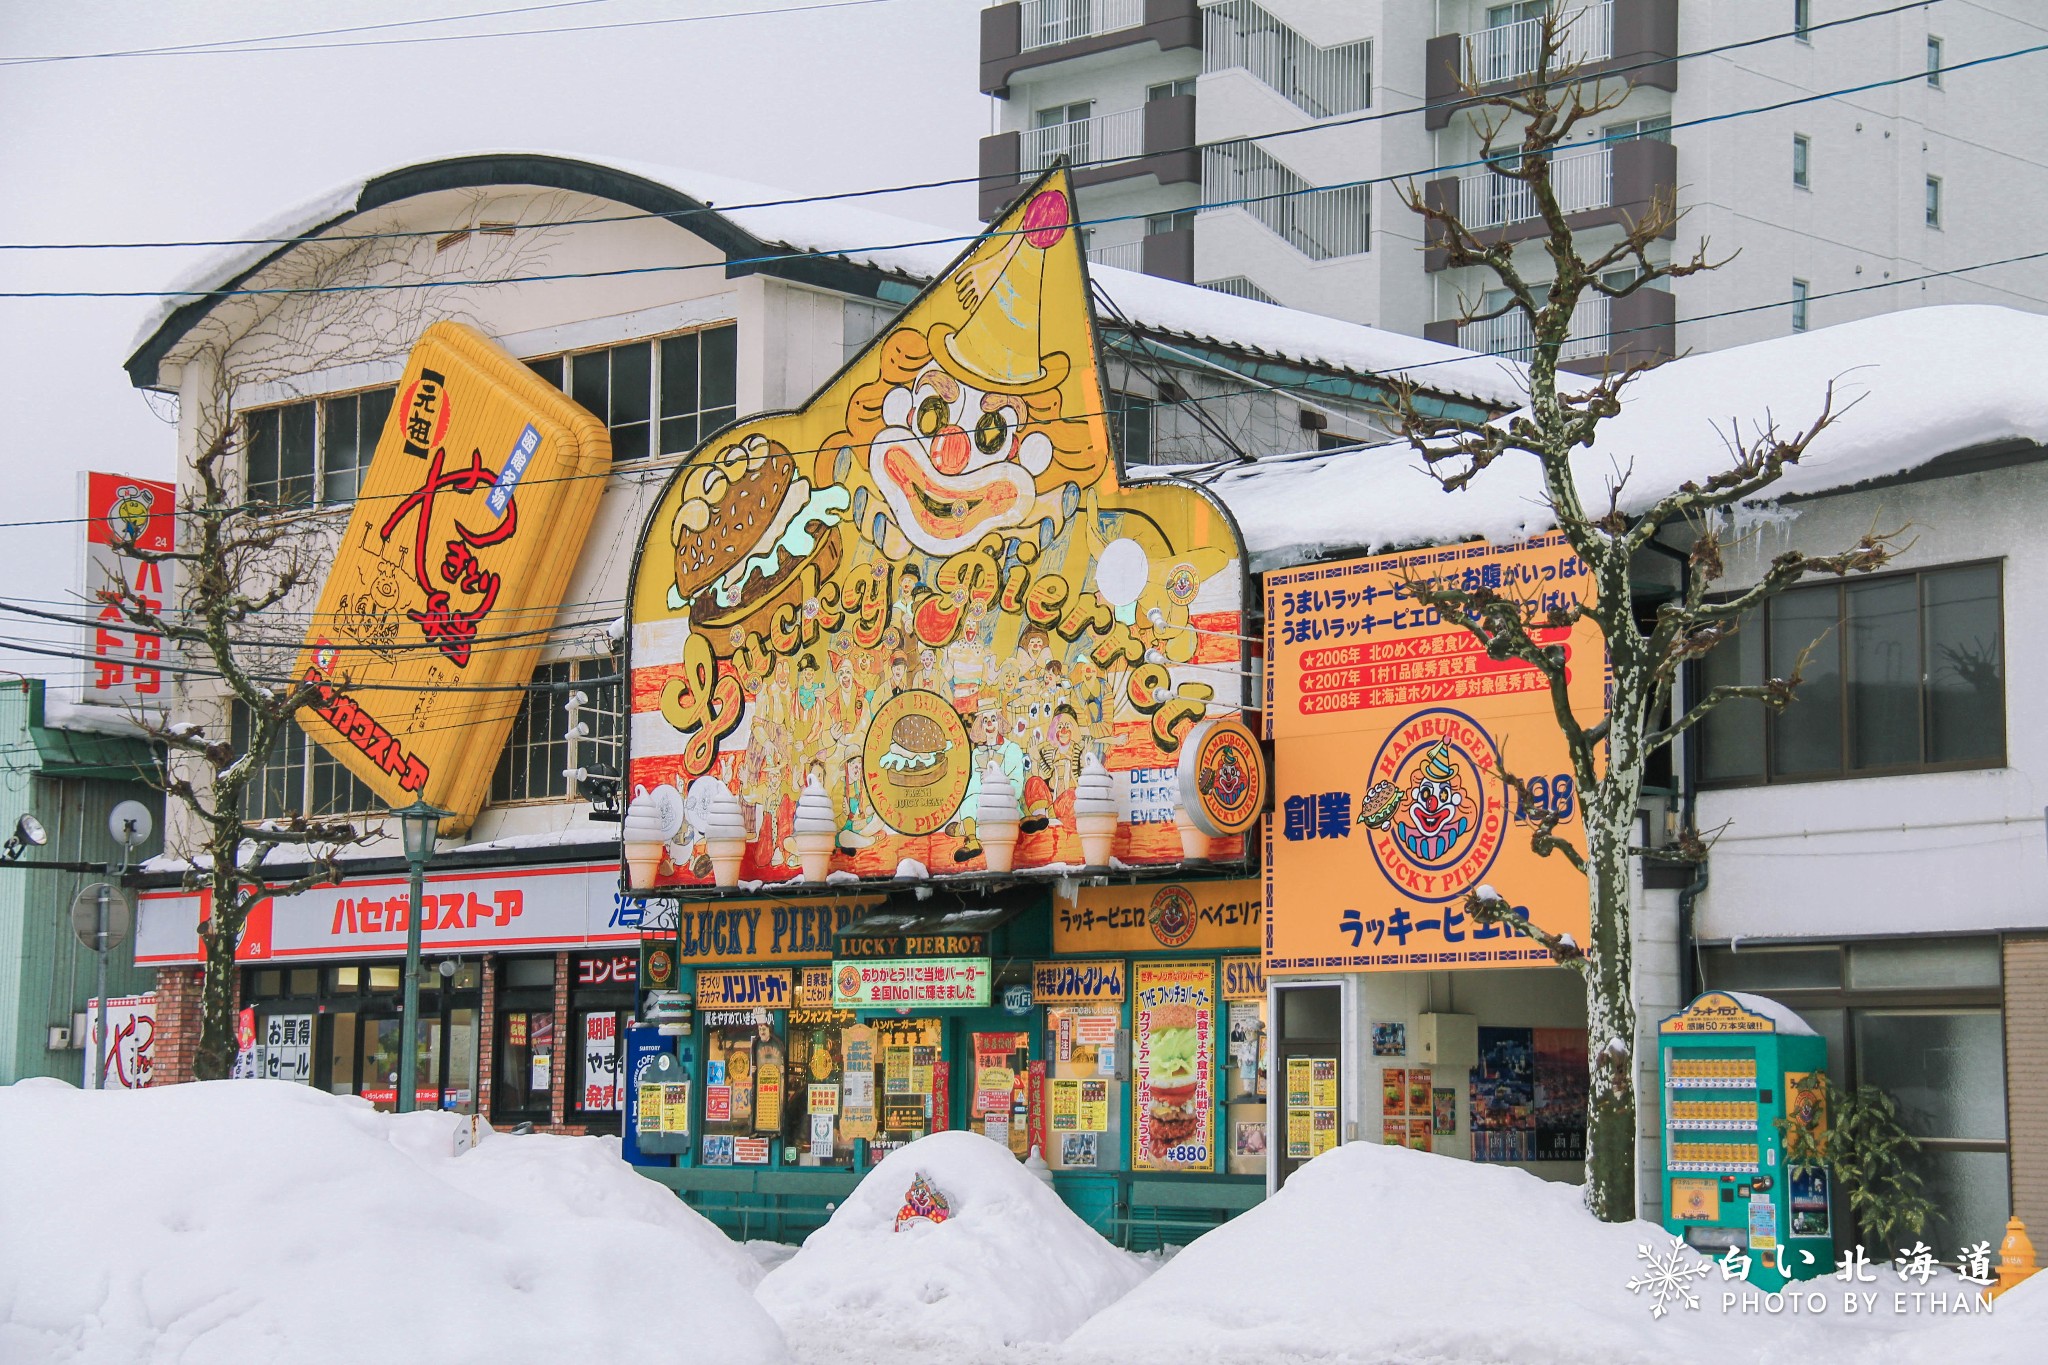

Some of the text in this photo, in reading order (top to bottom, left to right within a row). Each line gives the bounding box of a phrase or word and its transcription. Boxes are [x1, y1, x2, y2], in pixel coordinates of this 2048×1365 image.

[408, 384, 436, 445] 元祖
[490, 429, 538, 511] 函館名物
[154, 535, 167, 548] 24
[659, 562, 894, 776] Lucky
[1315, 649, 1362, 667] 2006年
[1315, 655, 1477, 689] 2007年 1村1品優秀賞受賞
[1315, 671, 1552, 712] 2008年 北海道ホクレン夢対象優秀賞受
[1204, 734, 1251, 766] HAMBURGER
[1380, 718, 1494, 777] HAMBURGER
[1208, 765, 1257, 822] LUCKY PIERROT
[1283, 792, 1352, 842] 創業
[1377, 796, 1501, 894] LUCKY PIERROT
[331, 889, 524, 935] ハセガワストア
[1060, 907, 1145, 932] ラッキーピエロ
[683, 907, 761, 957] LUCKY
[250, 943, 262, 956] 24
[840, 936, 982, 956] LUCKY PIERROT
[806, 973, 828, 987] 自家製
[861, 966, 986, 983] ありがとう!!ご当地バーガー
[1036, 966, 1121, 997] 特製ソフトクリーム
[701, 975, 787, 1003] 手づくり ハンバーガー
[806, 989, 827, 1001] こだわり
[870, 984, 976, 1001] 全国No1に輝きました
[1005, 993, 1032, 1009] WiFi
[1140, 987, 1157, 1009] THE
[788, 1009, 856, 1024] テレフォンオーダー
[1674, 1022, 1683, 1030] 祝
[268, 1020, 310, 1046] お買得
[267, 1057, 310, 1078] セール
[1167, 1145, 1207, 1162] ¥880
